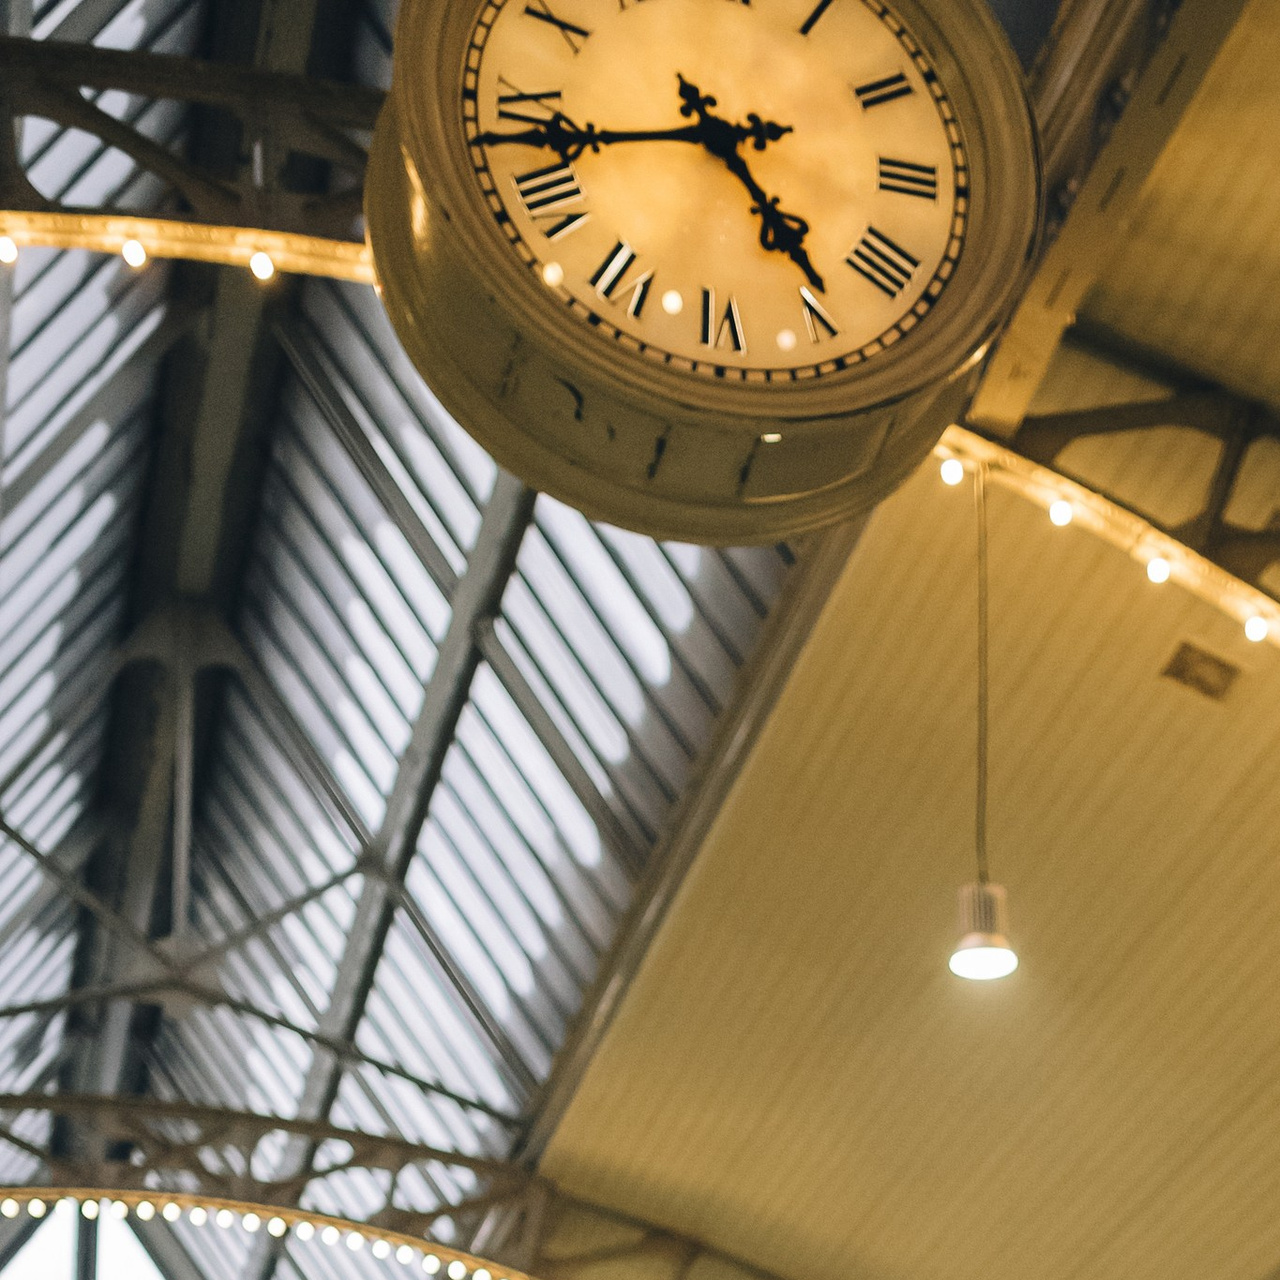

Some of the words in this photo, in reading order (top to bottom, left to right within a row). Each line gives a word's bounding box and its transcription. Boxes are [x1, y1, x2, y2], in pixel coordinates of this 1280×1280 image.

[854, 72, 915, 111] II
[511, 160, 593, 240] VIII
[876, 156, 938, 202] III
[588, 238, 657, 319] VII
[846, 225, 921, 299] IIII
[701, 285, 747, 356] VI
[799, 285, 840, 344] V
